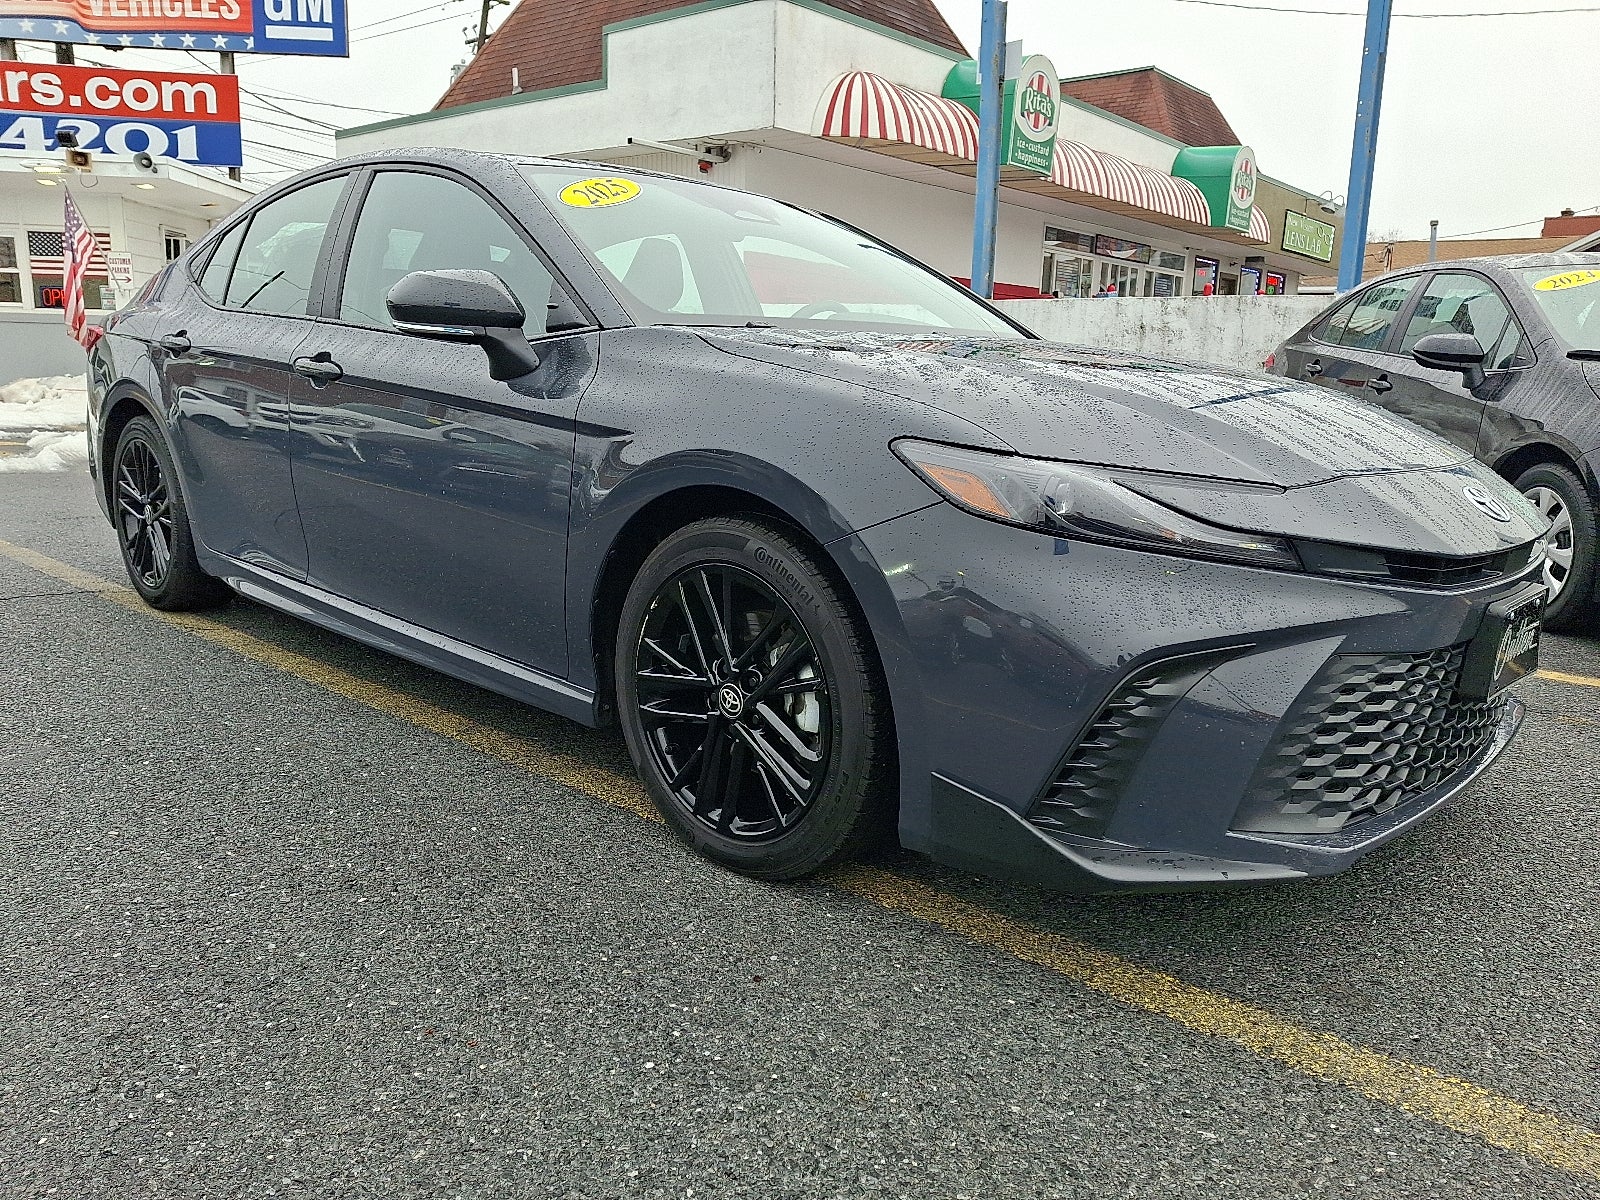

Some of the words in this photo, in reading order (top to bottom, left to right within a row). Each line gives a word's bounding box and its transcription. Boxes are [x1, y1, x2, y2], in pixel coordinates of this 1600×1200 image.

[0, 70, 218, 114] rs.com
[1025, 87, 1052, 118] Rita's
[0, 116, 200, 161] 4201
[573, 180, 628, 204] 2025
[1285, 230, 1306, 249] LENS
[1305, 236, 1322, 254] LAB
[109, 257, 132, 265] CUSTOMER
[754, 546, 815, 607] Continental
